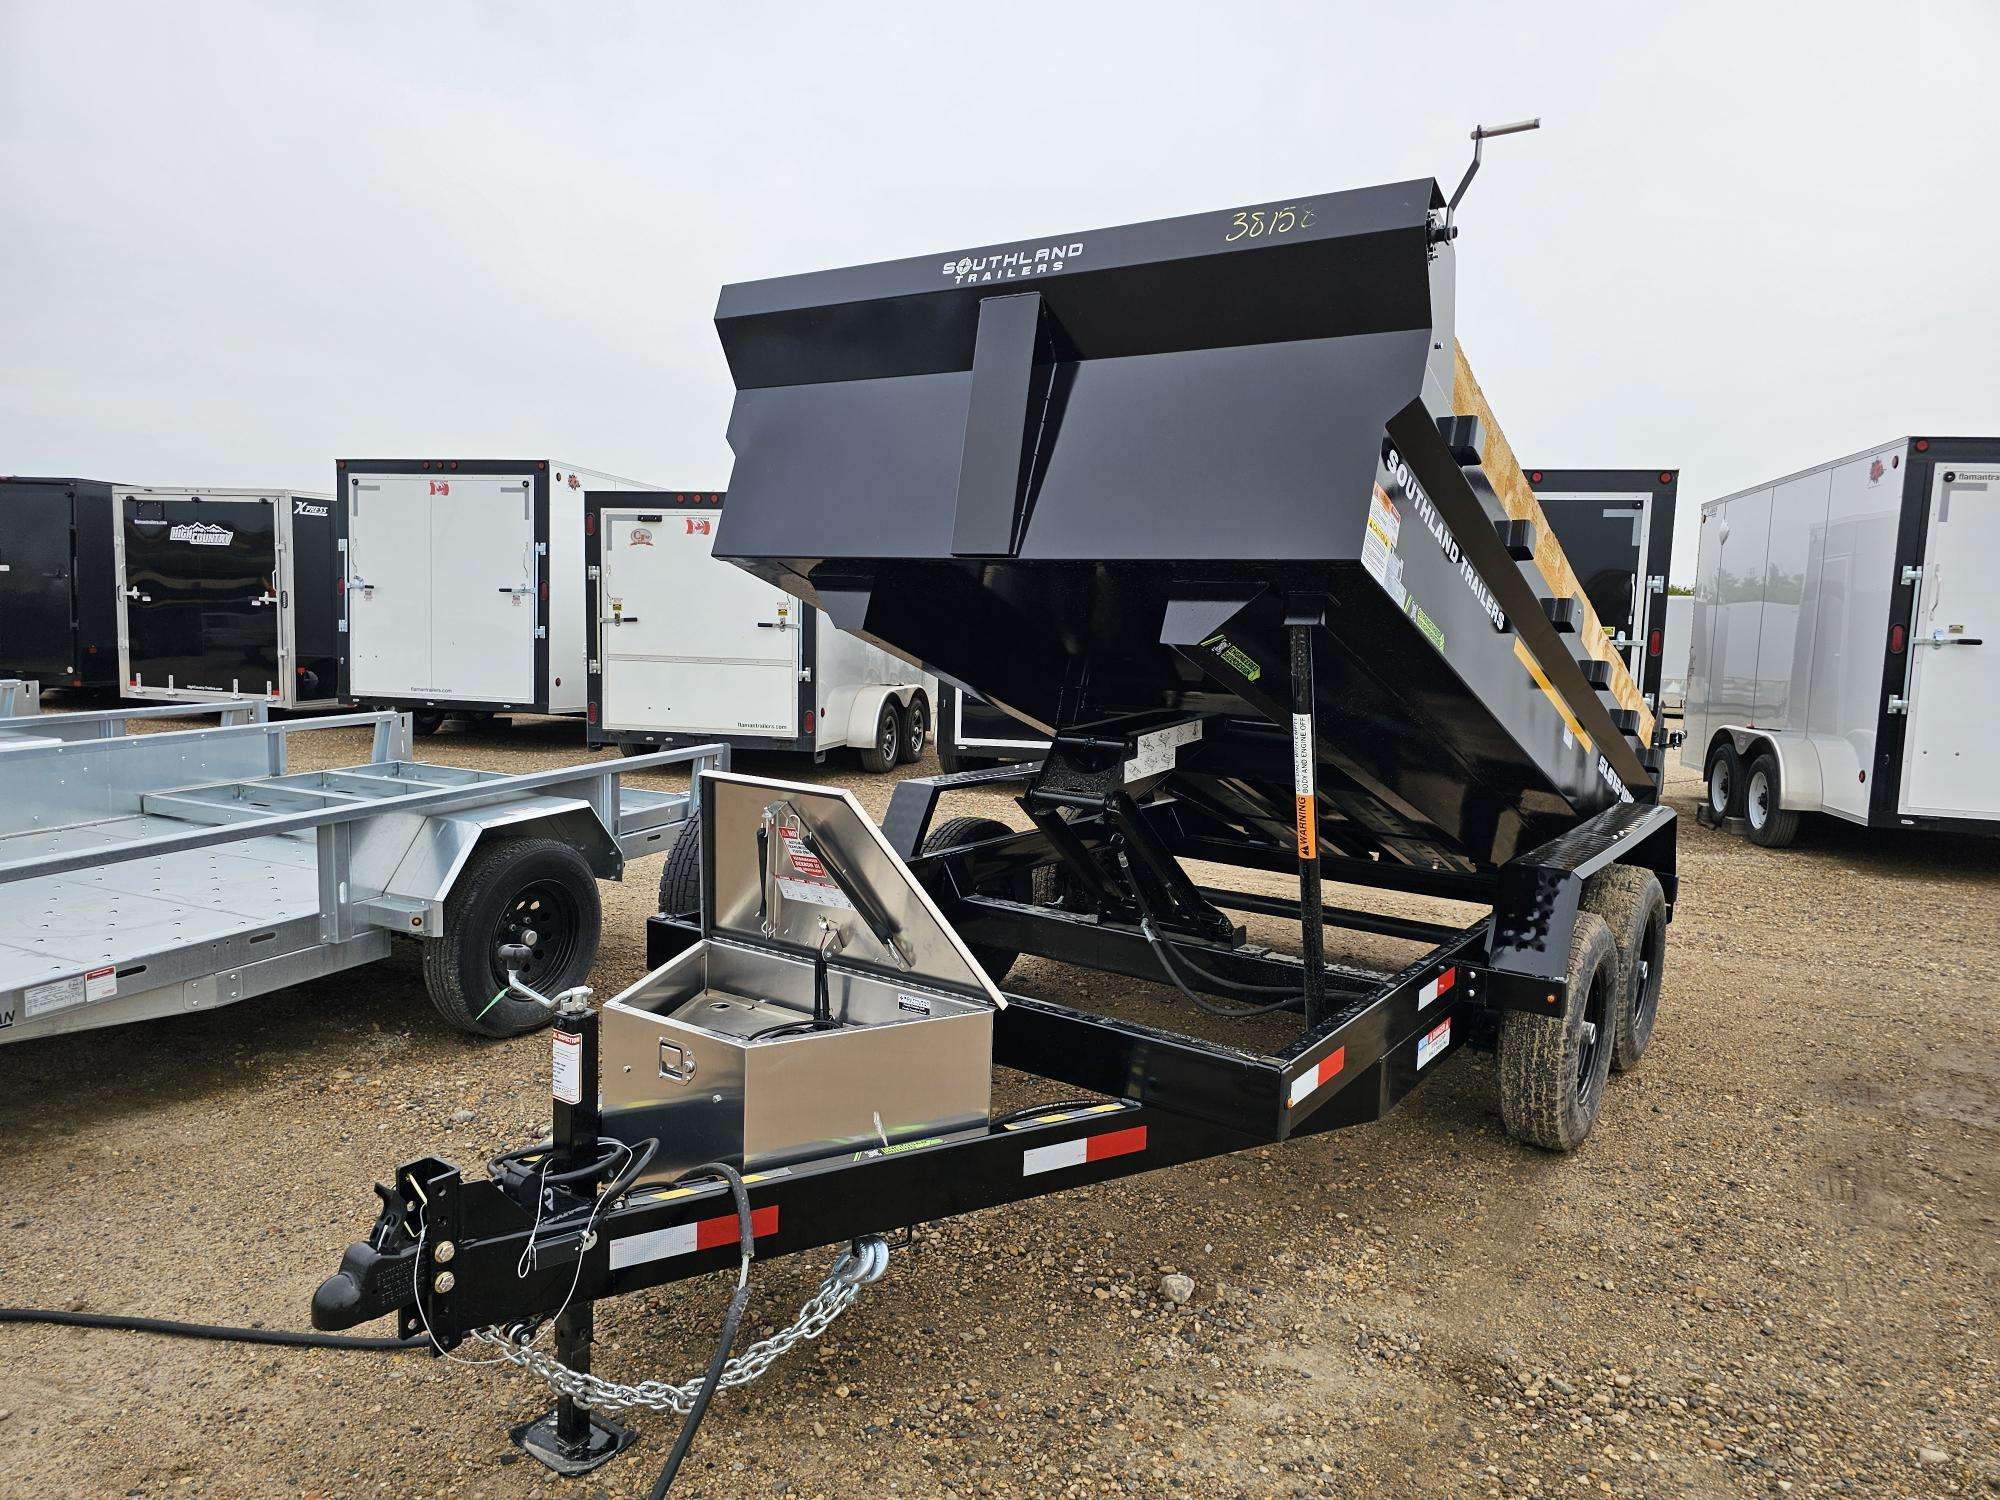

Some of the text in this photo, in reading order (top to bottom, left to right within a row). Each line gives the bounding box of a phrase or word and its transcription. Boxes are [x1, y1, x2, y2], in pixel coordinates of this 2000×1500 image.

[943, 243, 1084, 275] SOUTHLAND
[955, 261, 1064, 285] TRAILERS
[191, 533, 232, 544] COUNTRY
[1387, 449, 1460, 564] SOUTHLAND
[1461, 555, 1505, 631] TRAILERS
[1300, 732, 1308, 758] ENGINE
[1301, 775, 1309, 794] BODY
[1298, 796, 1308, 845] WARNING
